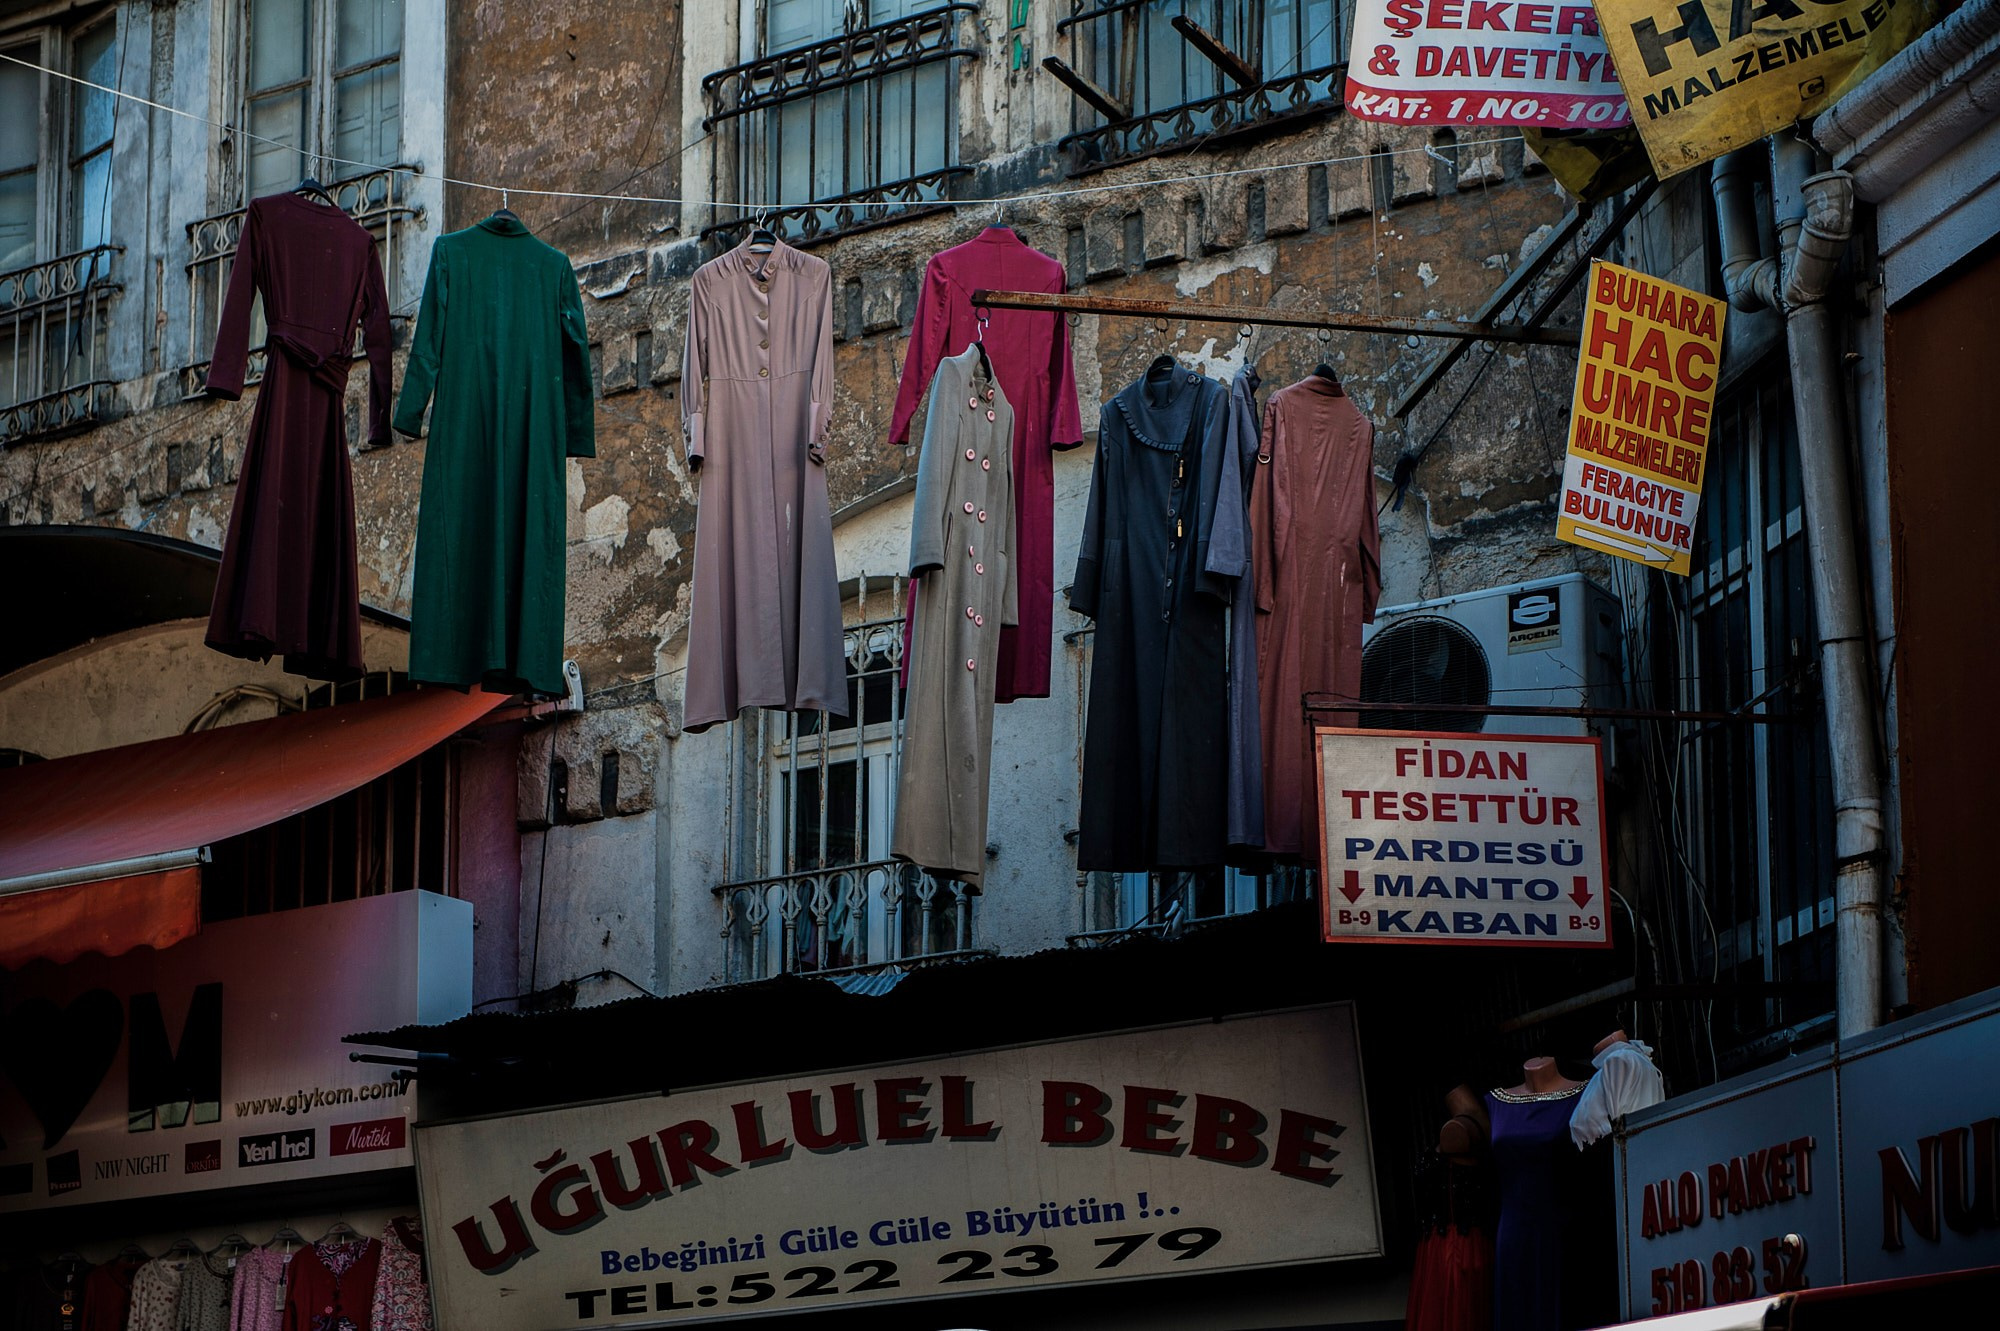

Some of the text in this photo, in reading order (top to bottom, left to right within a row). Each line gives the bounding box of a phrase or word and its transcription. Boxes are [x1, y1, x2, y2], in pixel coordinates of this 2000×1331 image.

[1384, 0, 1600, 38] ŞEKER
[1631, 0, 1846, 78] HA
[1368, 44, 1400, 77] &
[1643, 0, 1897, 121] MALZEMELE
[1352, 91, 1432, 119] KAT:
[1478, 98, 1550, 121] NO:
[1595, 267, 1717, 342] BUHARA
[1588, 308, 1715, 392] HAC
[1582, 362, 1710, 447] UMRE
[1564, 489, 1691, 549] BULUNUR
[1395, 740, 1528, 781] FİDAN
[1342, 787, 1581, 826] TESETTÜR
[1345, 838, 1583, 866] PARDESÜ
[1374, 874, 1559, 901] MANTO
[1338, 909, 1371, 926] B-9
[1377, 909, 1558, 936] KABAN
[1568, 915, 1600, 931] B-9
[235, 1079, 398, 1117] www.giykom.com
[345, 1125, 391, 1151] Nurteks
[126, 1153, 170, 1177] NIGHT
[452, 1075, 1347, 1273] UĞURLUEL BEBE
[1641, 1135, 1816, 1239] ALO PAKET
[600, 1233, 766, 1275] Bebeğinizi
[779, 1225, 859, 1256] Güle
[868, 1216, 952, 1246] Güle
[966, 1197, 1126, 1237] Büyütün
[937, 1244, 1060, 1284] 23
[1094, 1226, 1222, 1270] 79
[1712, 1245, 1756, 1305] 83
[1763, 1232, 1810, 1295] 52
